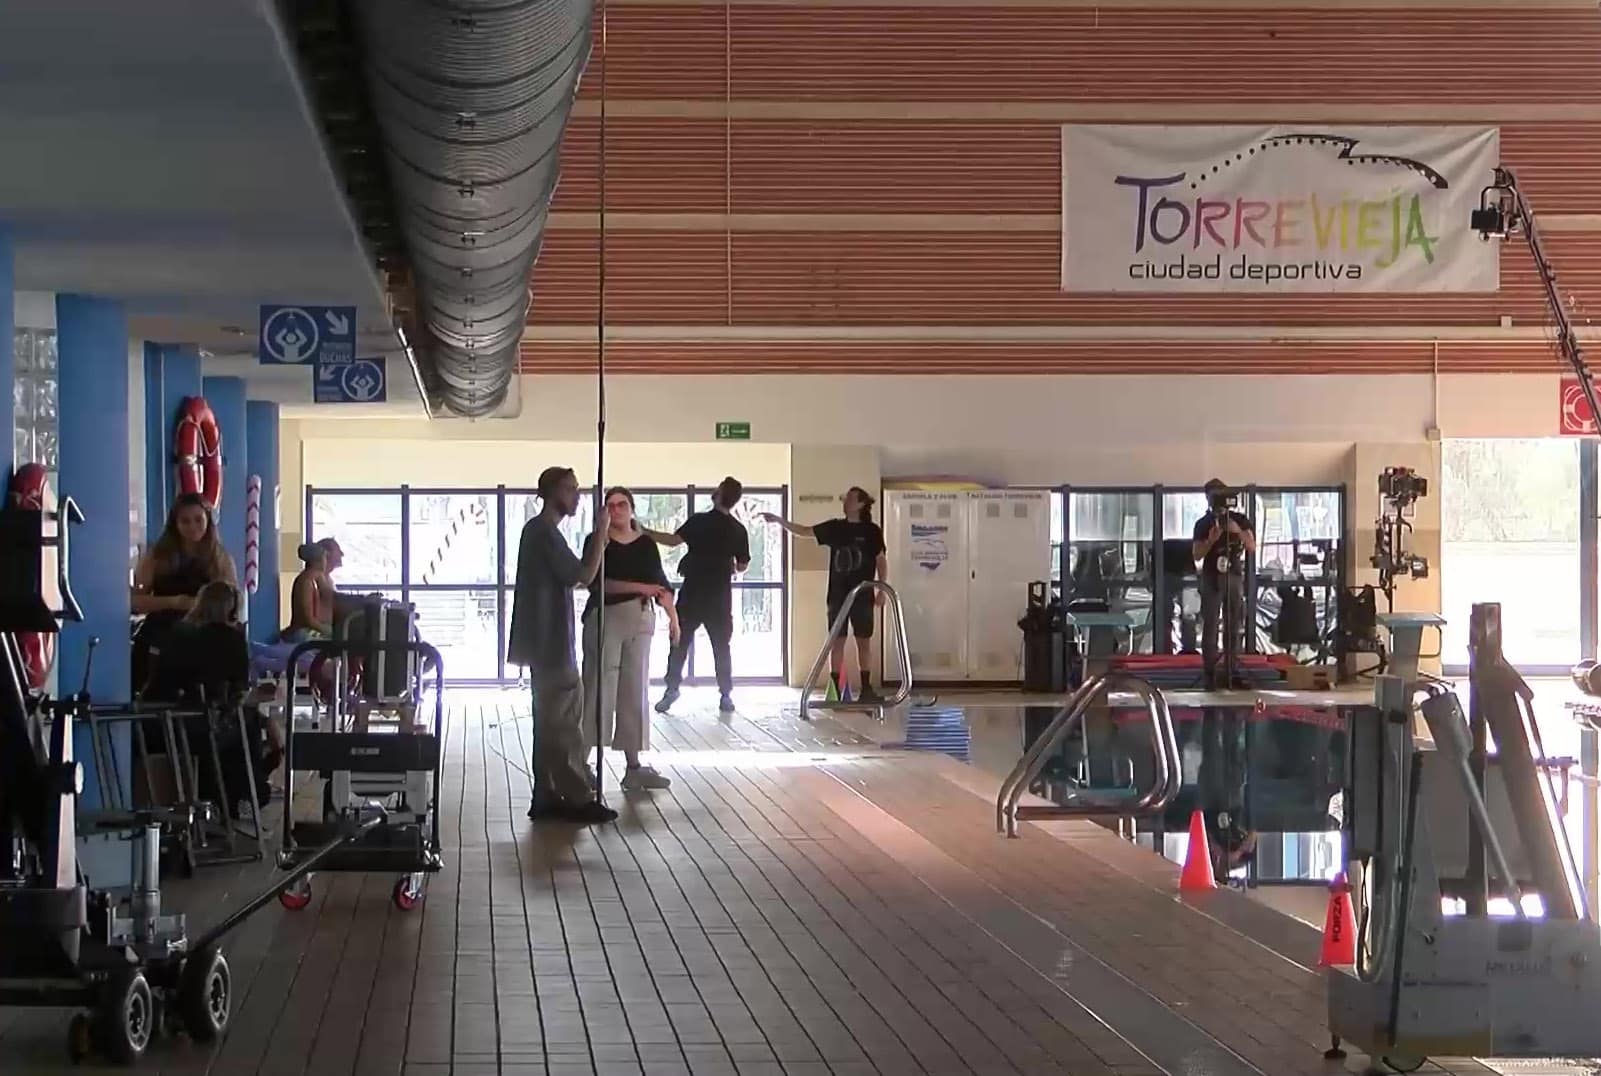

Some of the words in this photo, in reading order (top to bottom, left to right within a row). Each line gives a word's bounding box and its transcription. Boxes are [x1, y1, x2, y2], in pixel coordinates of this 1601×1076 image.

[1114, 171, 1440, 269] TORREVIEJA
[1129, 254, 1220, 279] ciudad
[1230, 254, 1362, 284] deportiva
